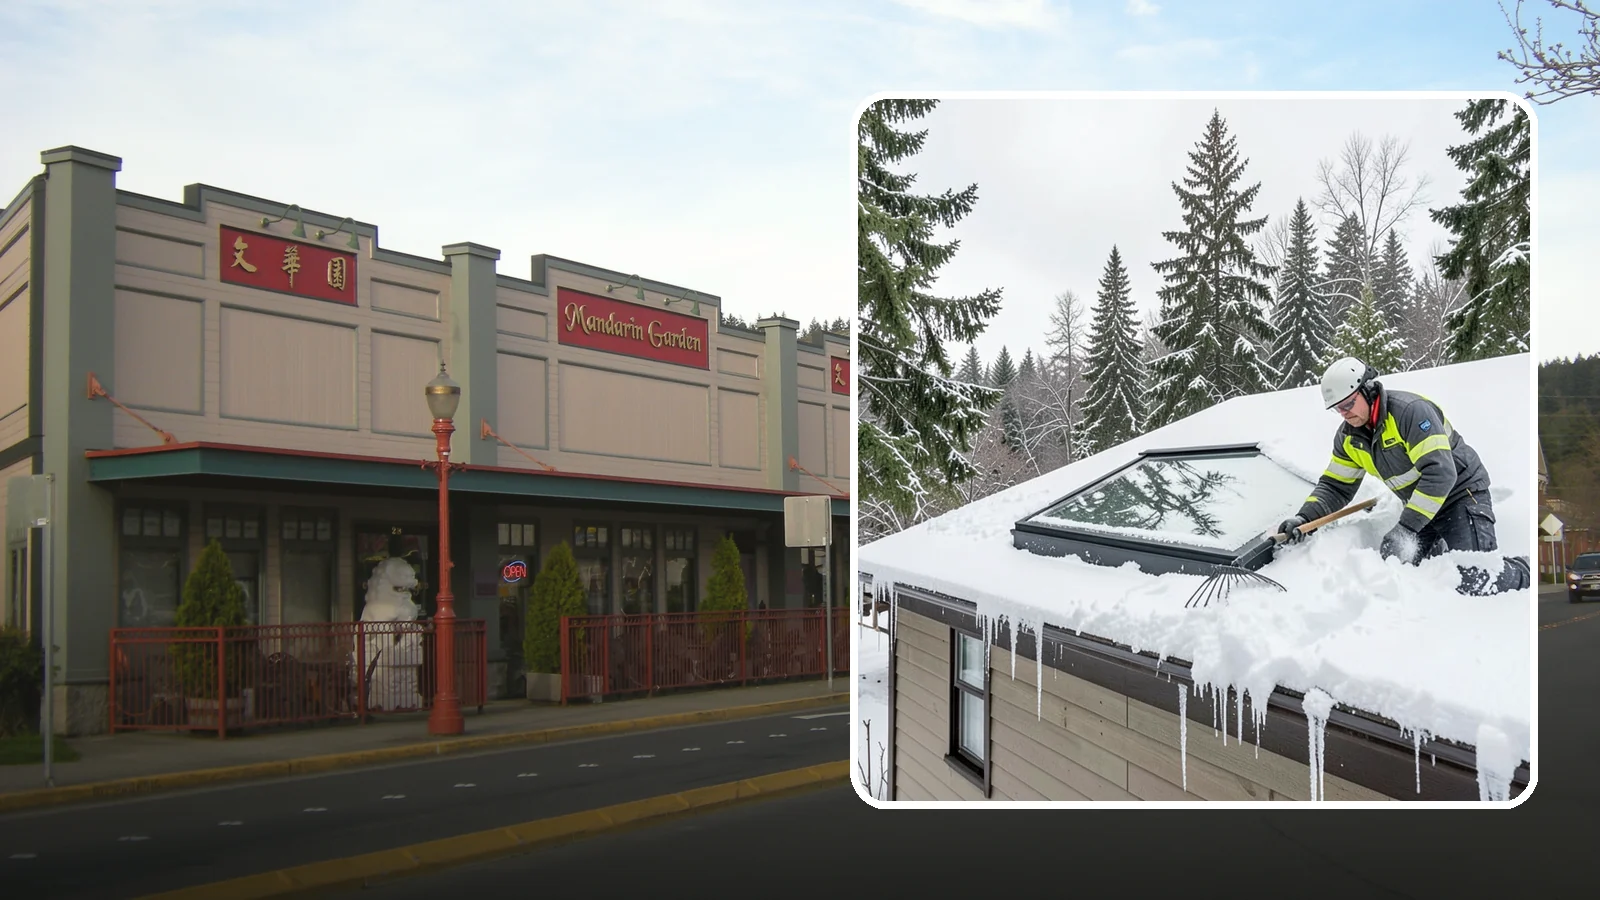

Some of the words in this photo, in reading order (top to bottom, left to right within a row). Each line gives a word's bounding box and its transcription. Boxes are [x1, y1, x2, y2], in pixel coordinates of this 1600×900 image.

[231, 236, 346, 291] 文華園
[564, 302, 644, 340] Mandarin
[648, 320, 702, 352] Garden
[503, 565, 527, 578] OPEN
